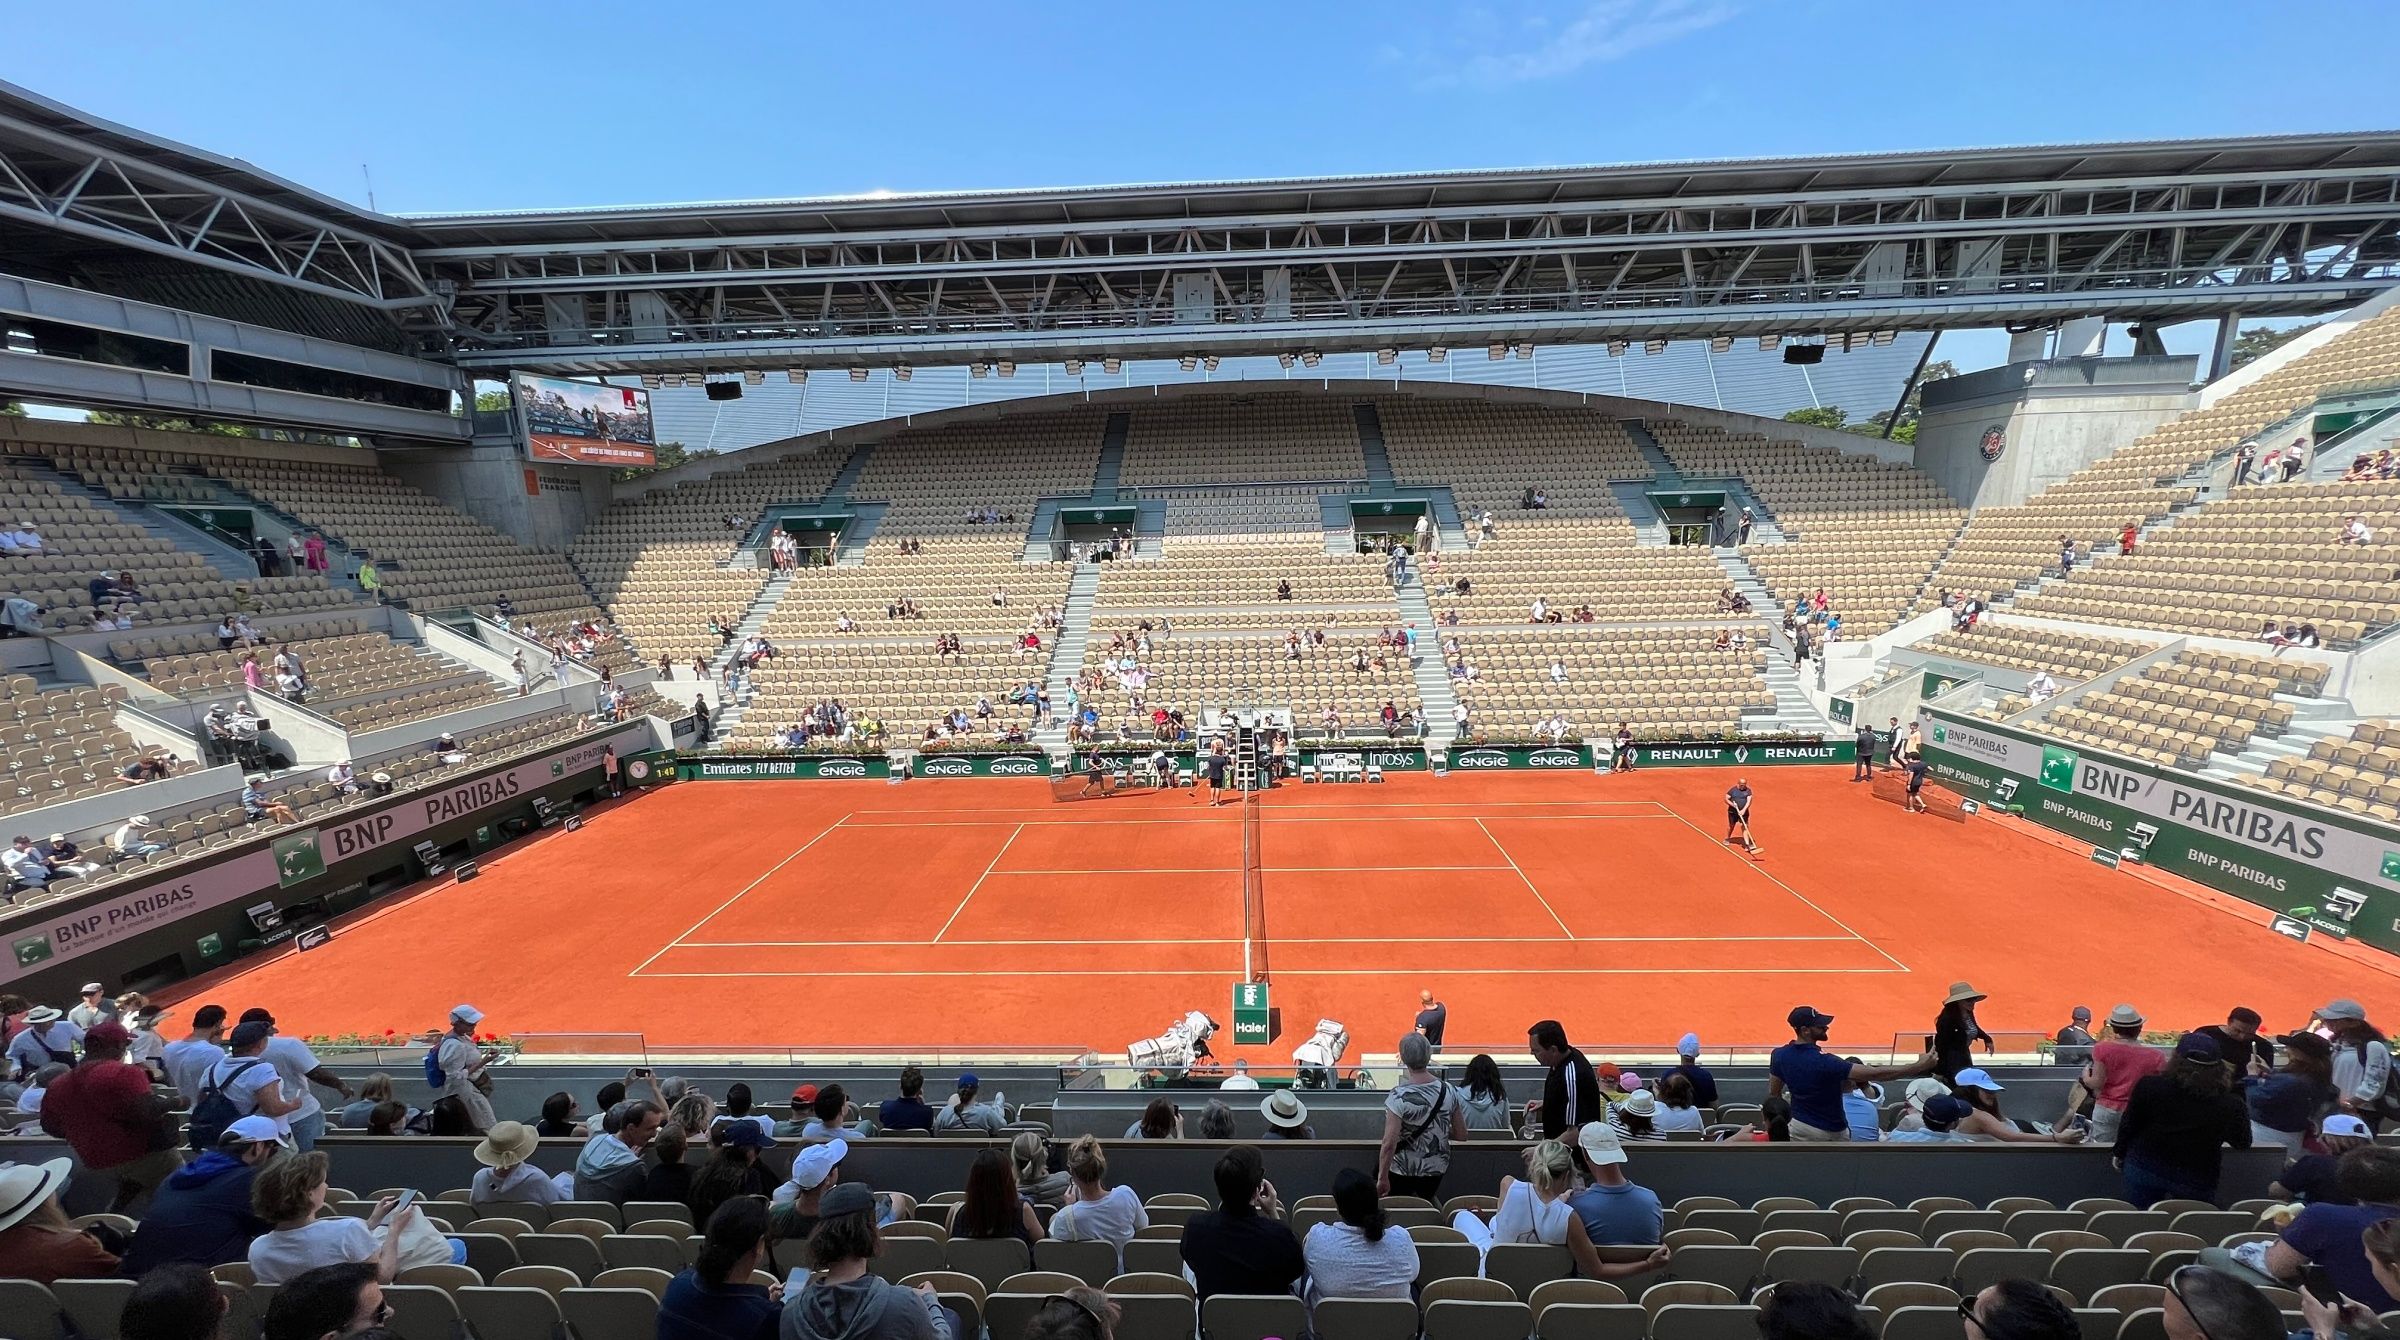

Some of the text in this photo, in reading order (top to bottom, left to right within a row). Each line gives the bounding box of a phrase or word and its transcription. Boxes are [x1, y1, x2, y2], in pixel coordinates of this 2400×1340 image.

[1829, 711, 1850, 724] ROLEX
[1948, 729, 1967, 743] BNP
[1968, 735, 2008, 755] PARIBAS
[565, 753, 582, 767] BNP
[583, 743, 609, 760] PARIBA
[1370, 751, 1414, 767] Infosys
[1651, 749, 1722, 760] RENAULT
[1765, 747, 1836, 758] RENAULT
[656, 767, 675, 778] 1:40
[702, 762, 796, 775] Emirates FLY BETTER
[1937, 764, 1991, 789] BNP PARIBAS
[334, 772, 519, 857] BNP PARIBAS
[2043, 799, 2113, 832] BNP PARIBAS
[2081, 764, 2326, 860] BNP PARIBAS
[2093, 853, 2117, 865] LACOSTE
[2188, 848, 2287, 892] BNP PARIBAS
[55, 884, 194, 944] BNP PARIBAS
[2310, 917, 2347, 935] LACOSTE
[262, 929, 293, 945] LACOSTE
[1236, 1022, 1266, 1033] Haier
